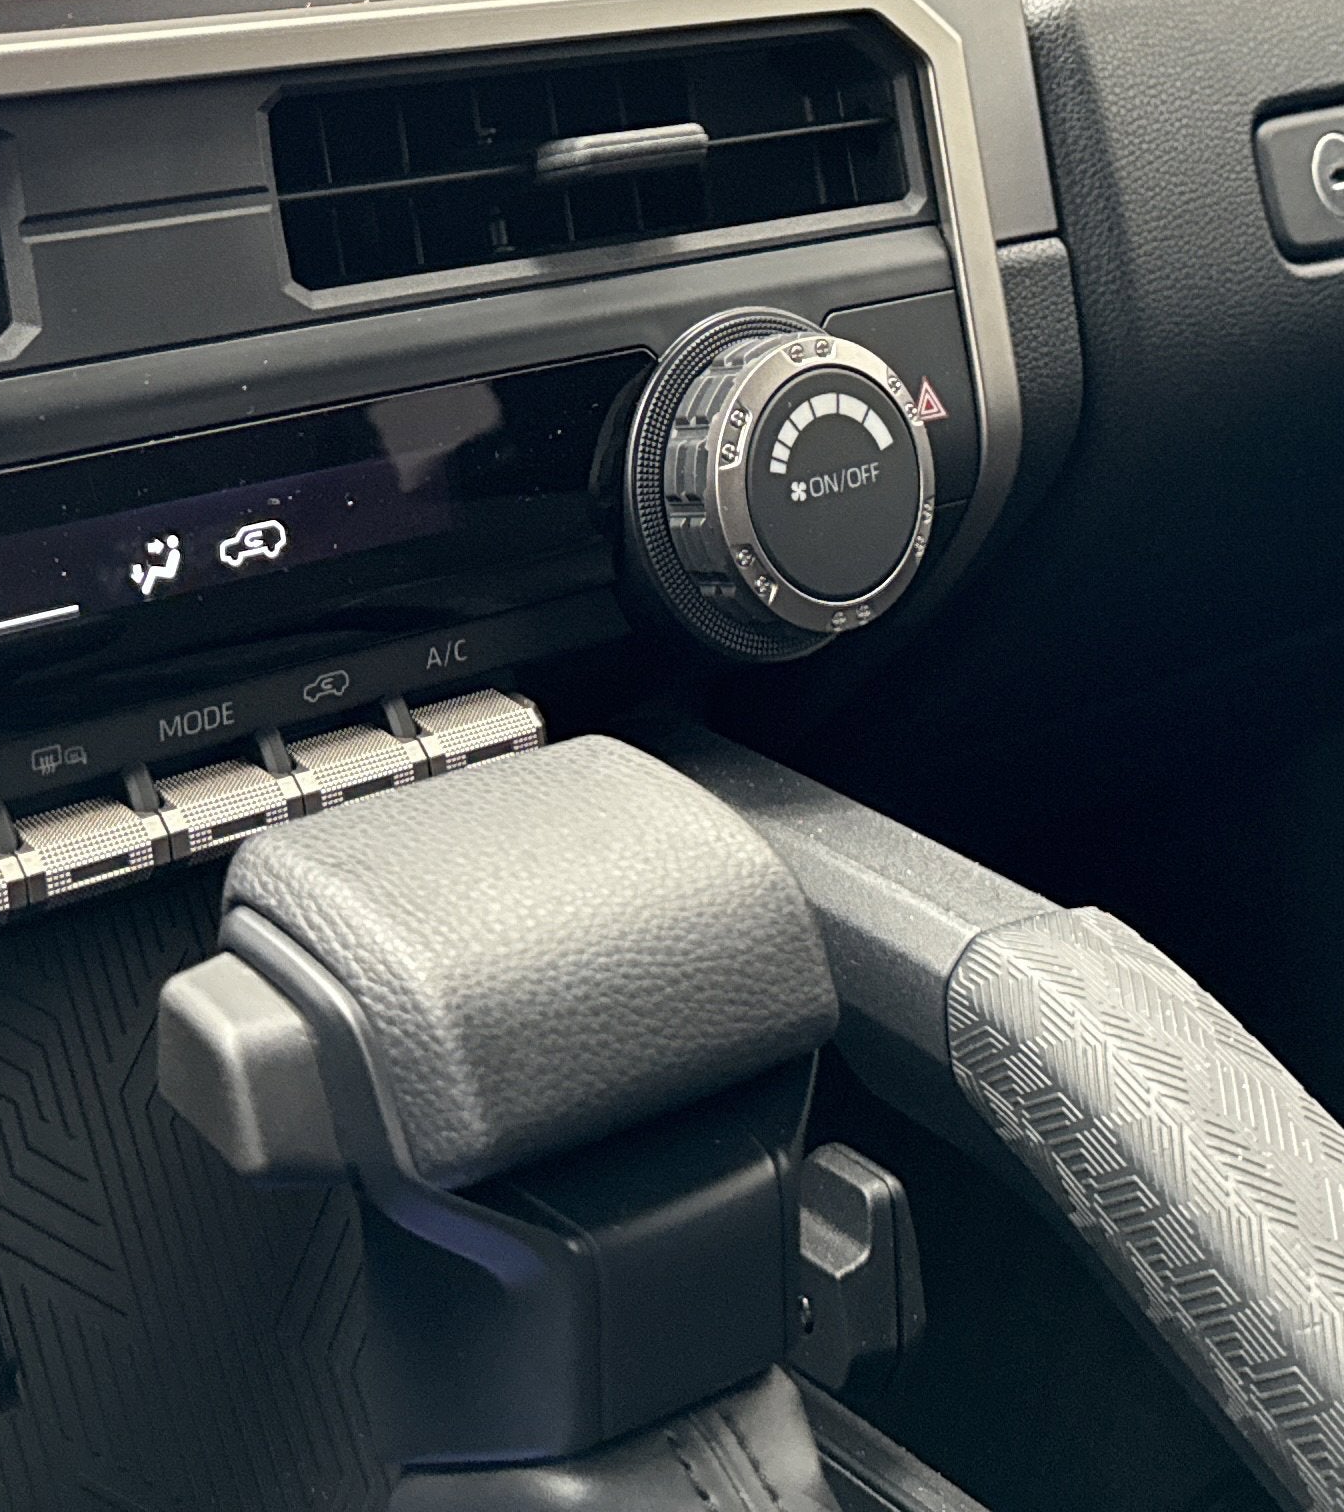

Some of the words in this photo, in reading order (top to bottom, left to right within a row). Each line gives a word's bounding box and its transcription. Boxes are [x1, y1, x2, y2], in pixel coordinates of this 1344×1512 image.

[808, 461, 881, 500] ON/OFF
[425, 638, 468, 671] A/C
[158, 701, 236, 742] MODE
